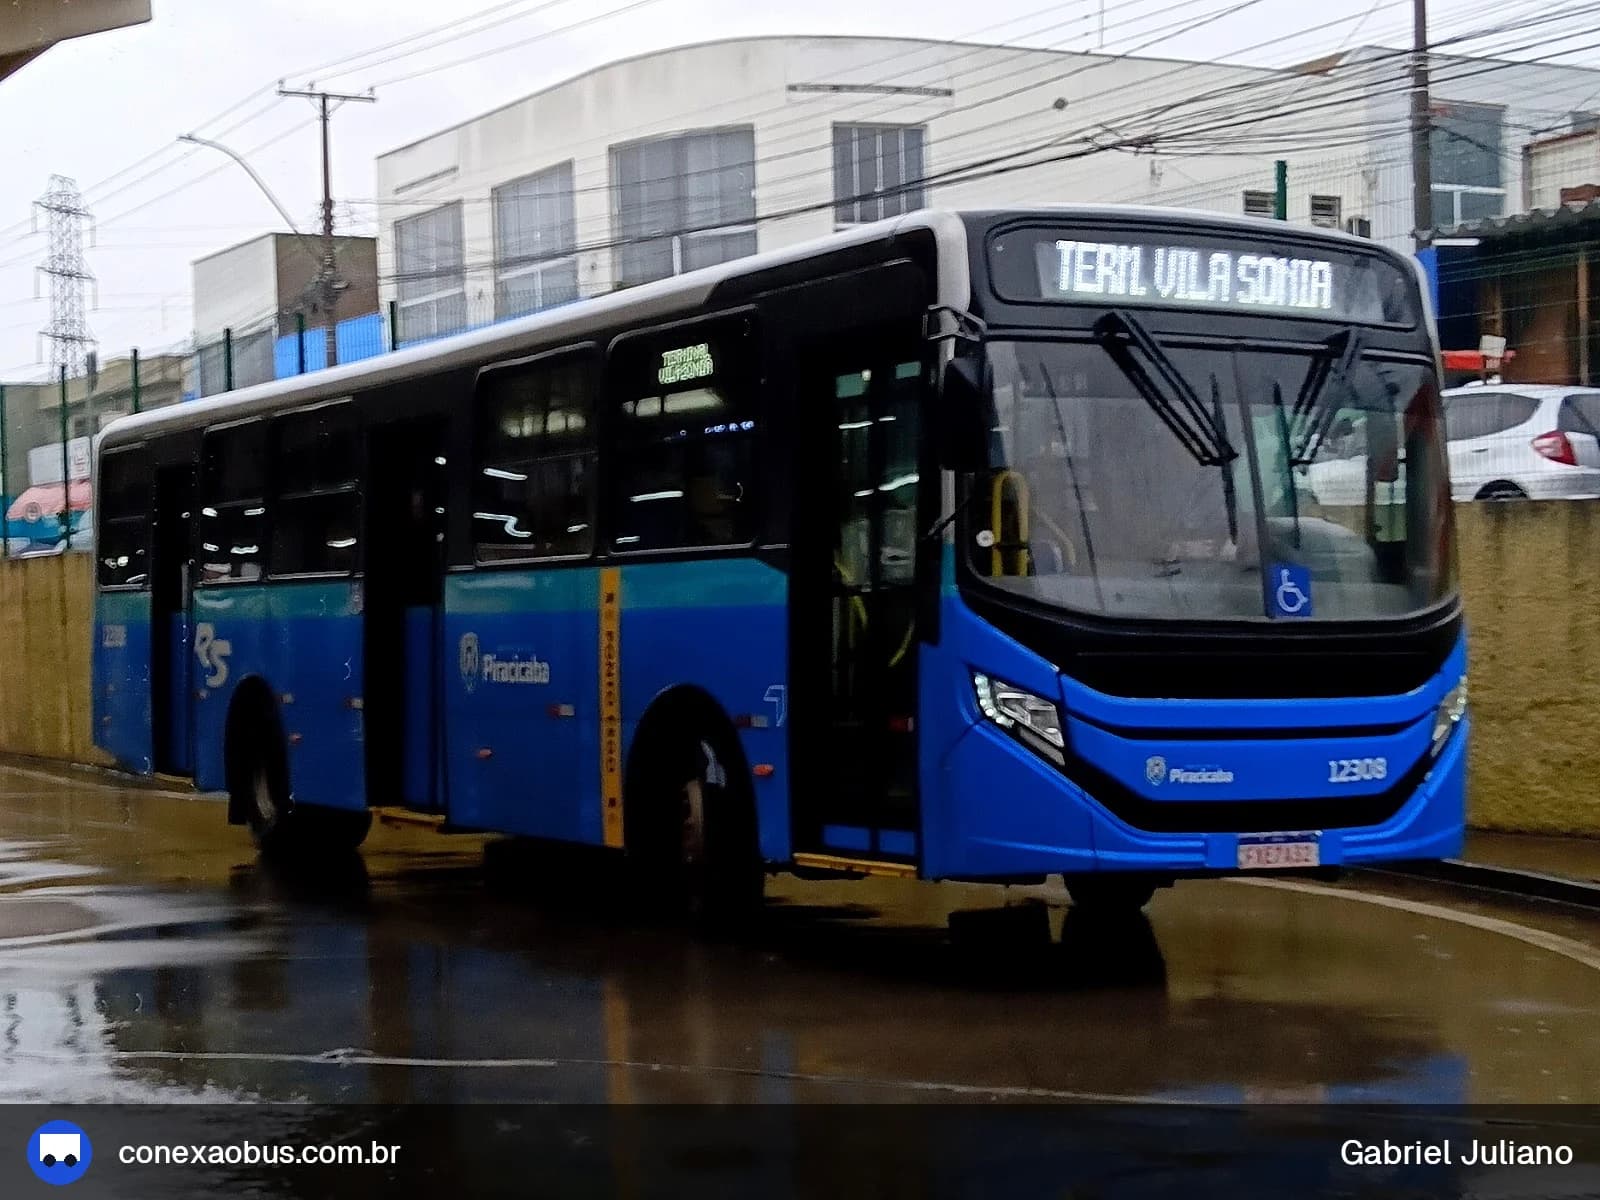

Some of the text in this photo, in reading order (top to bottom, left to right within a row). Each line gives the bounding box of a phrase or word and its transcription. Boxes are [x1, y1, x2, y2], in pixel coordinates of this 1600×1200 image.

[1153, 246, 1231, 302] VILA
[1236, 254, 1333, 309] SONIA
[483, 653, 550, 685] Piracicaba
[1169, 767, 1235, 784] Piracicaba
[1328, 757, 1388, 783] 12308
